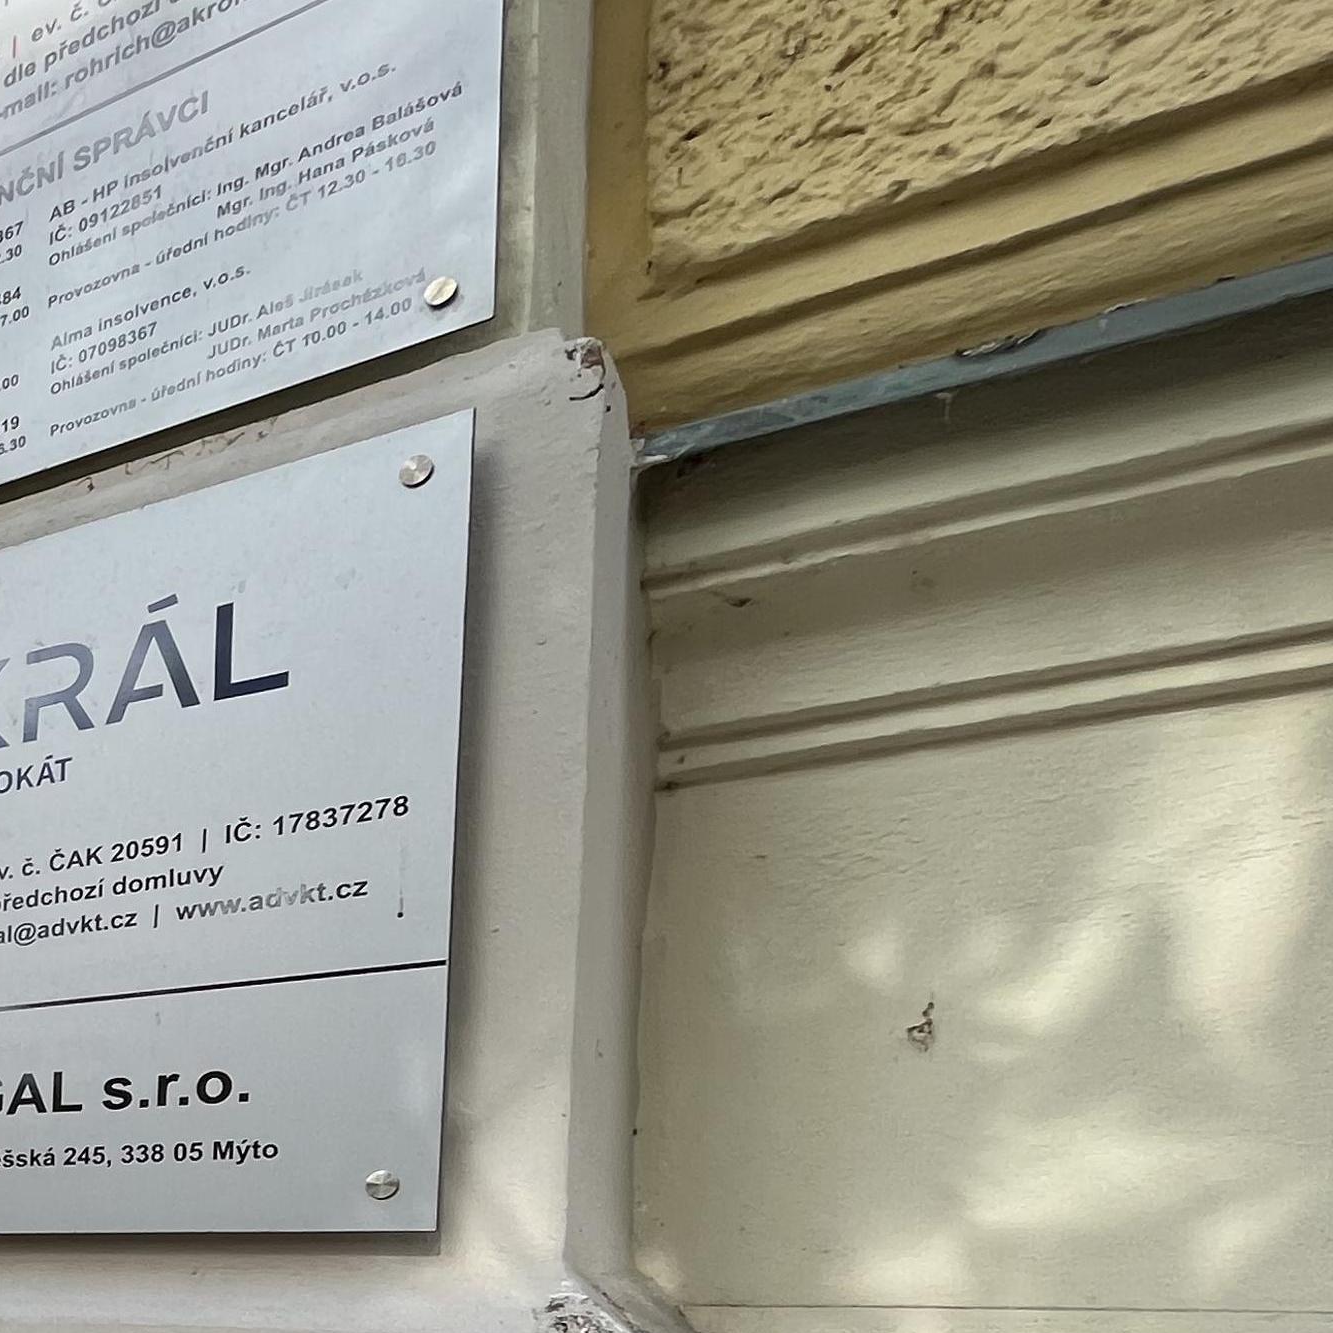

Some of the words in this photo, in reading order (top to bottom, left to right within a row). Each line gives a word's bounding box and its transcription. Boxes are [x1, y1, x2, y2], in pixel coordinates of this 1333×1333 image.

[31, 18, 62, 43] ev.
[3, 61, 36, 88] dle
[49, 199, 76, 223] AB
[92, 179, 119, 203] HP
[123, 127, 234, 190] insolvenční
[239, 86, 333, 139] kancelář,
[339, 63, 397, 93] v.o.s.
[72, 89, 209, 172] SPRÁVCI
[48, 226, 117, 266] Ohlášení
[122, 189, 211, 237] společníci:
[216, 176, 249, 197] Ing.
[255, 157, 292, 181] Mgr.
[297, 125, 366, 163] Andrea
[371, 81, 462, 131] Balášová
[216, 196, 253, 219] Mgr.
[259, 180, 292, 201] Ing.
[298, 157, 345, 185] Hana
[351, 116, 435, 163] Pásková
[48, 263, 141, 309] Provozovna
[155, 231, 209, 265] úřední
[214, 206, 280, 242] hodiny:
[285, 189, 312, 212] ČT
[317, 169, 366, 199] 12.30
[49, 223, 72, 246] IČ:
[50, 325, 93, 352] Alma
[98, 287, 197, 332] insolvence,
[203, 265, 251, 290] v.o.s.
[207, 335, 252, 360] JUDr.
[257, 316, 304, 342] Marta
[50, 359, 115, 395] Ohlášení
[119, 329, 203, 371] společníci:
[207, 312, 253, 337] JUDr.
[256, 293, 294, 320] Aleš
[50, 354, 73, 375] IČ:
[78, 321, 158, 364] 07098367
[50, 398, 137, 437] Provozovna
[151, 371, 202, 402] úřední
[205, 351, 267, 383] hodiny:
[272, 337, 297, 358] ČT
[301, 320, 347, 347] 10.00
[364, 297, 413, 325] 14.00
[21, 857, 40, 877] č.
[49, 845, 103, 872] ČAK
[110, 832, 182, 863] 20591
[225, 816, 261, 844] IČ:
[272, 795, 409, 836] 17837278
[112, 865, 224, 895] domluvy
[176, 880, 368, 920] www.advkt.cz
[102, 1070, 250, 1111] s.r.o.
[63, 1146, 112, 1168] 245,
[121, 1143, 165, 1164] 338
[173, 1142, 203, 1162] 05
[212, 1138, 279, 1165] Mýto
